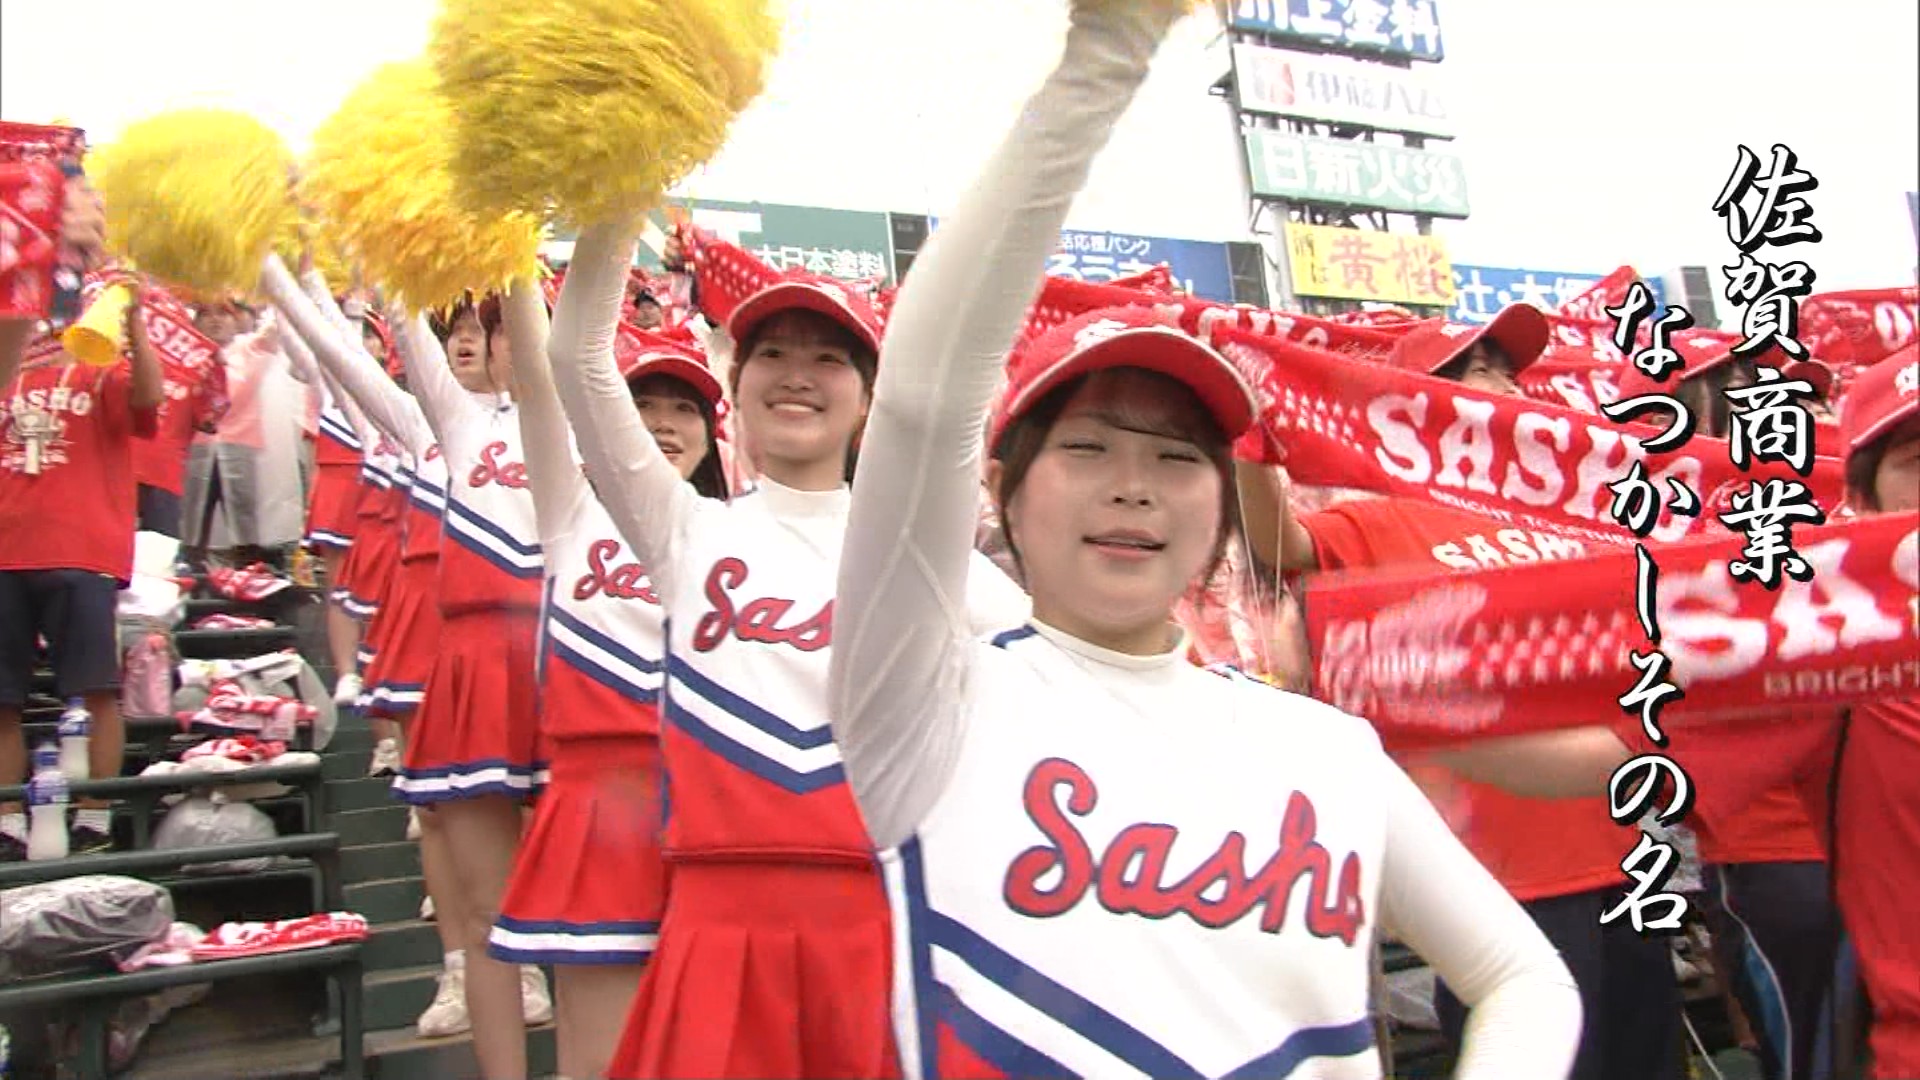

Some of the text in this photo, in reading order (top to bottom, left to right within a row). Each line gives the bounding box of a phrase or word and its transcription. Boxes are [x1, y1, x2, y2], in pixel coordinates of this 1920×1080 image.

[752, 243, 887, 280] 大日本塗料
[1328, 234, 1452, 300] 黄桜
[1367, 391, 1701, 542] SASHO
